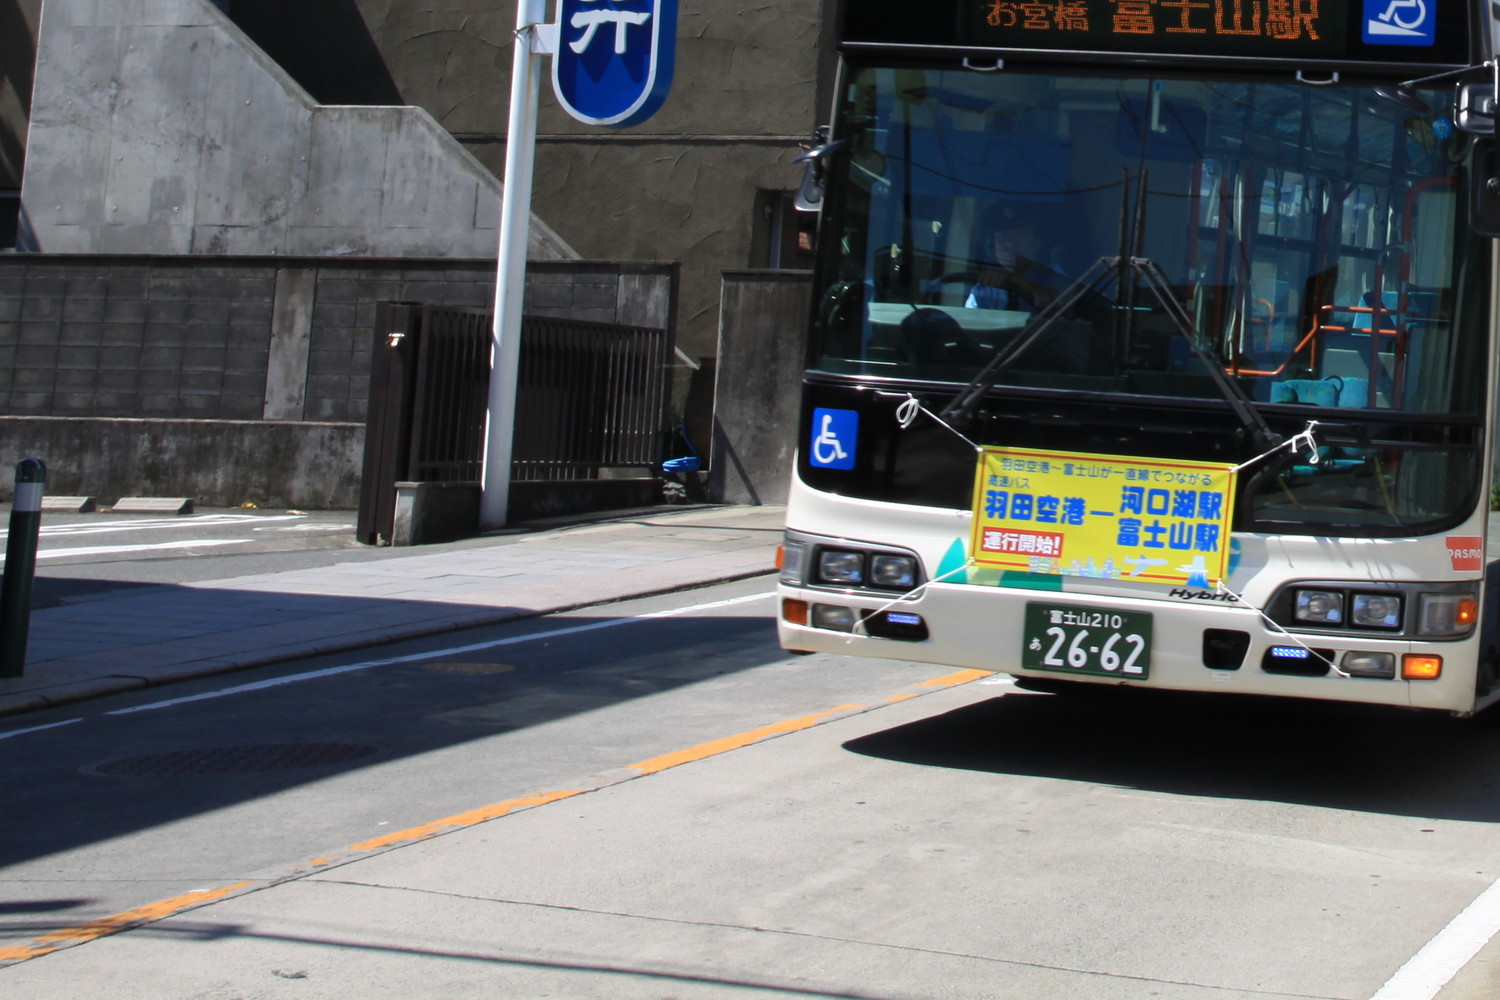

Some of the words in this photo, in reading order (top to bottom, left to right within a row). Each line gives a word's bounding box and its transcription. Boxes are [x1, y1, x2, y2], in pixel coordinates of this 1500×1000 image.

[987, 474, 1031, 489] 高速バス
[1000, 457, 1213, 486] 羽田空港～富士山が一直線でつながる
[1119, 485, 1223, 520] 河口湖駅
[1116, 517, 1220, 552] 富士山駅
[1168, 587, 1242, 602] Hybrid
[1050, 609, 1122, 629] 富士山210
[1043, 626, 1145, 674] 26-62
